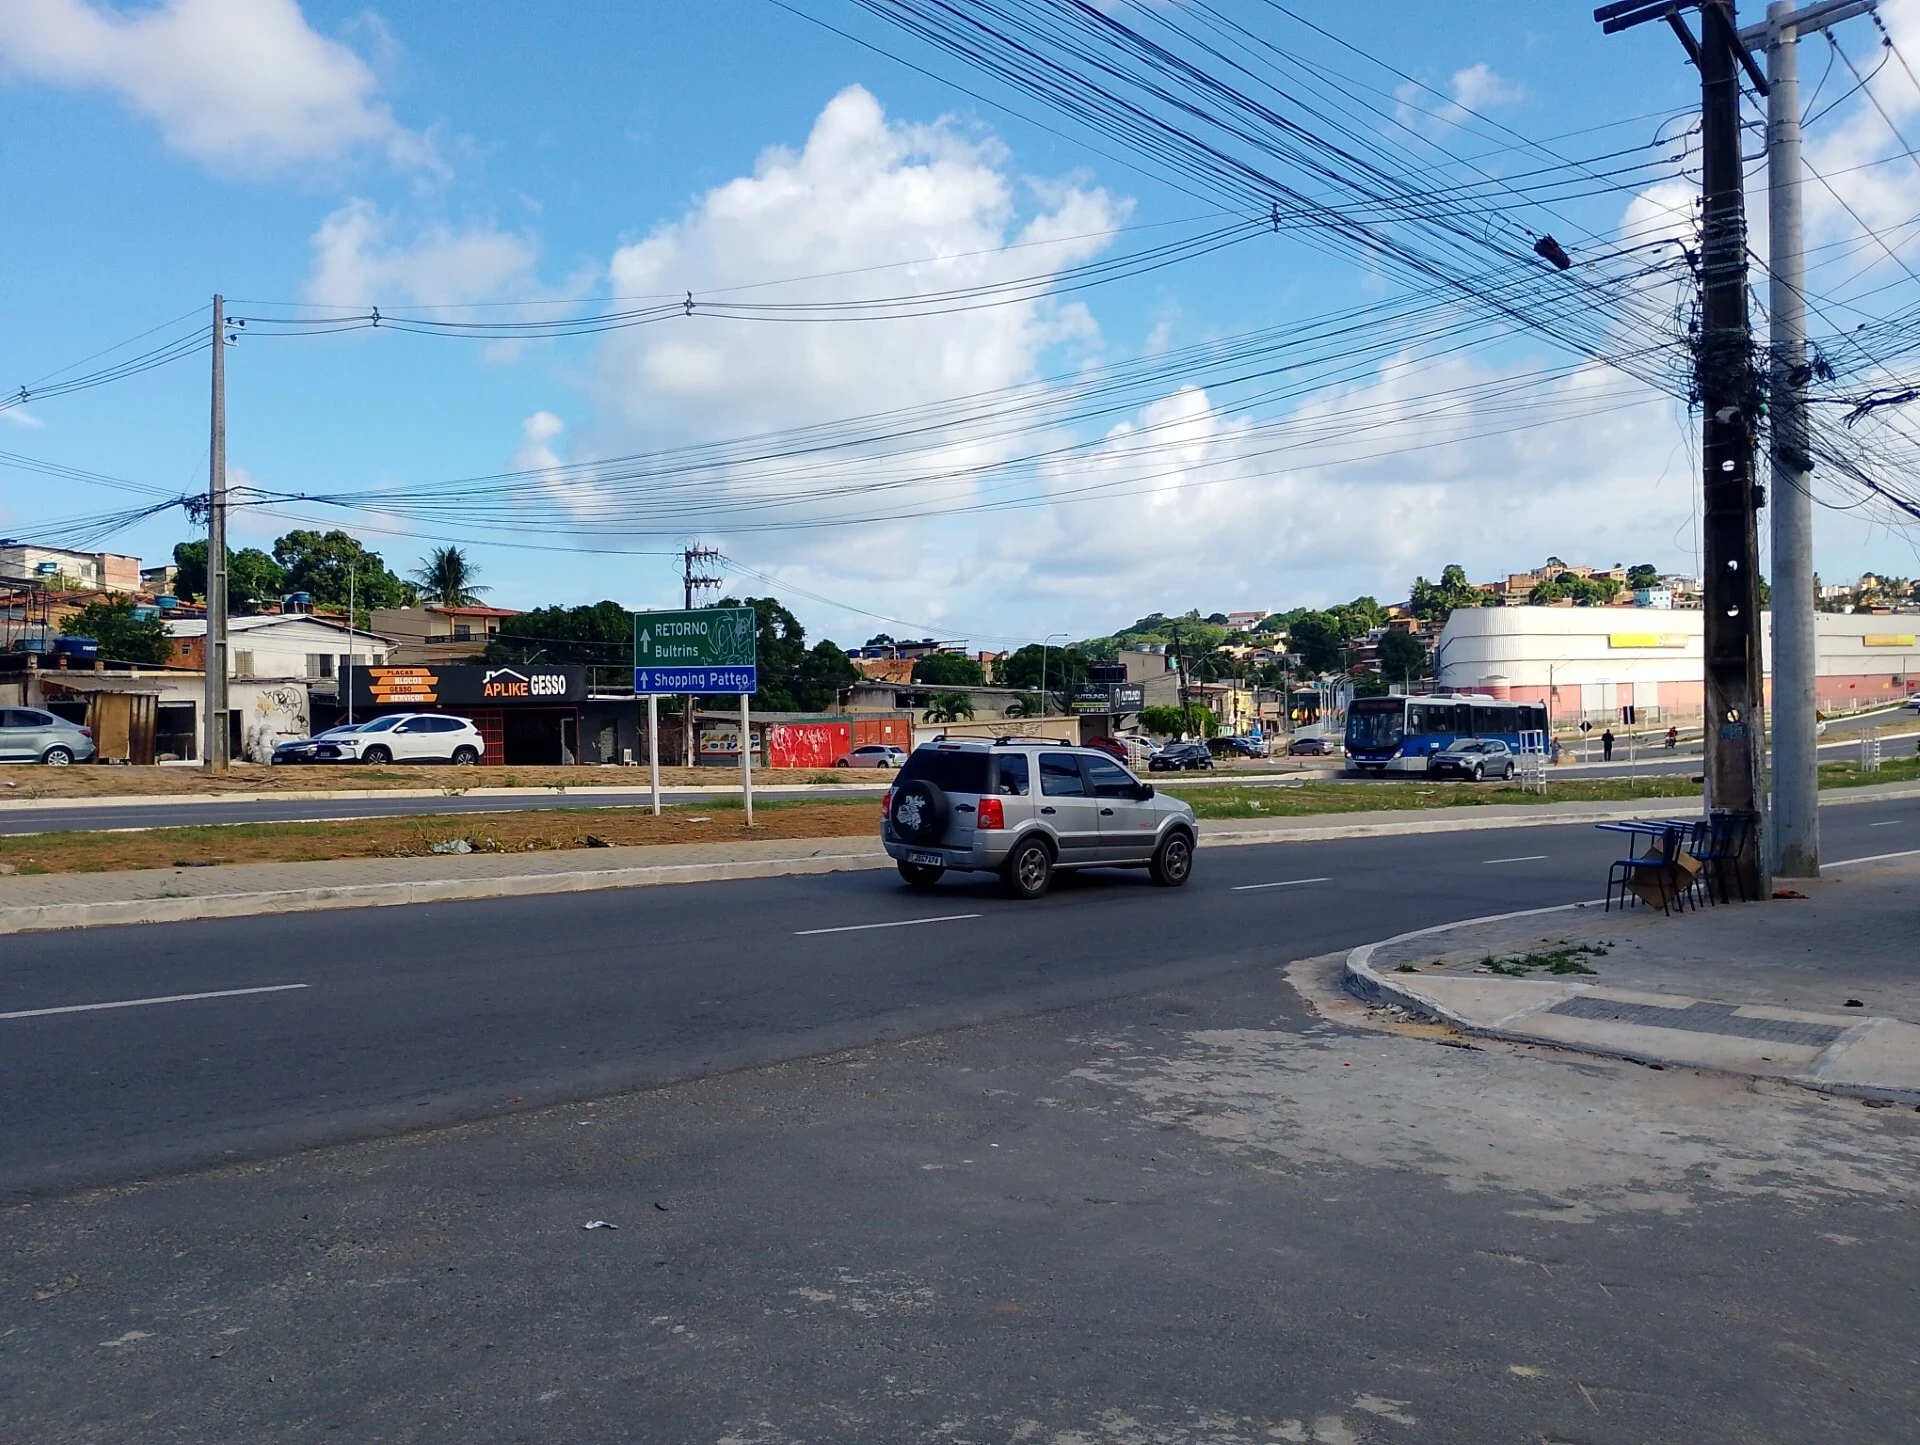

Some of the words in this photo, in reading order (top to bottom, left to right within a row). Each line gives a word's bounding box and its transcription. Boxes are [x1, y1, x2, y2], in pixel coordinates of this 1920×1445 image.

[655, 622, 708, 636] RETORNO
[655, 644, 699, 658] Bultrins
[484, 683, 529, 697] APLIKE
[530, 674, 566, 696] GESSO
[654, 672, 705, 689] Shopping
[710, 672, 748, 686] Patteo
